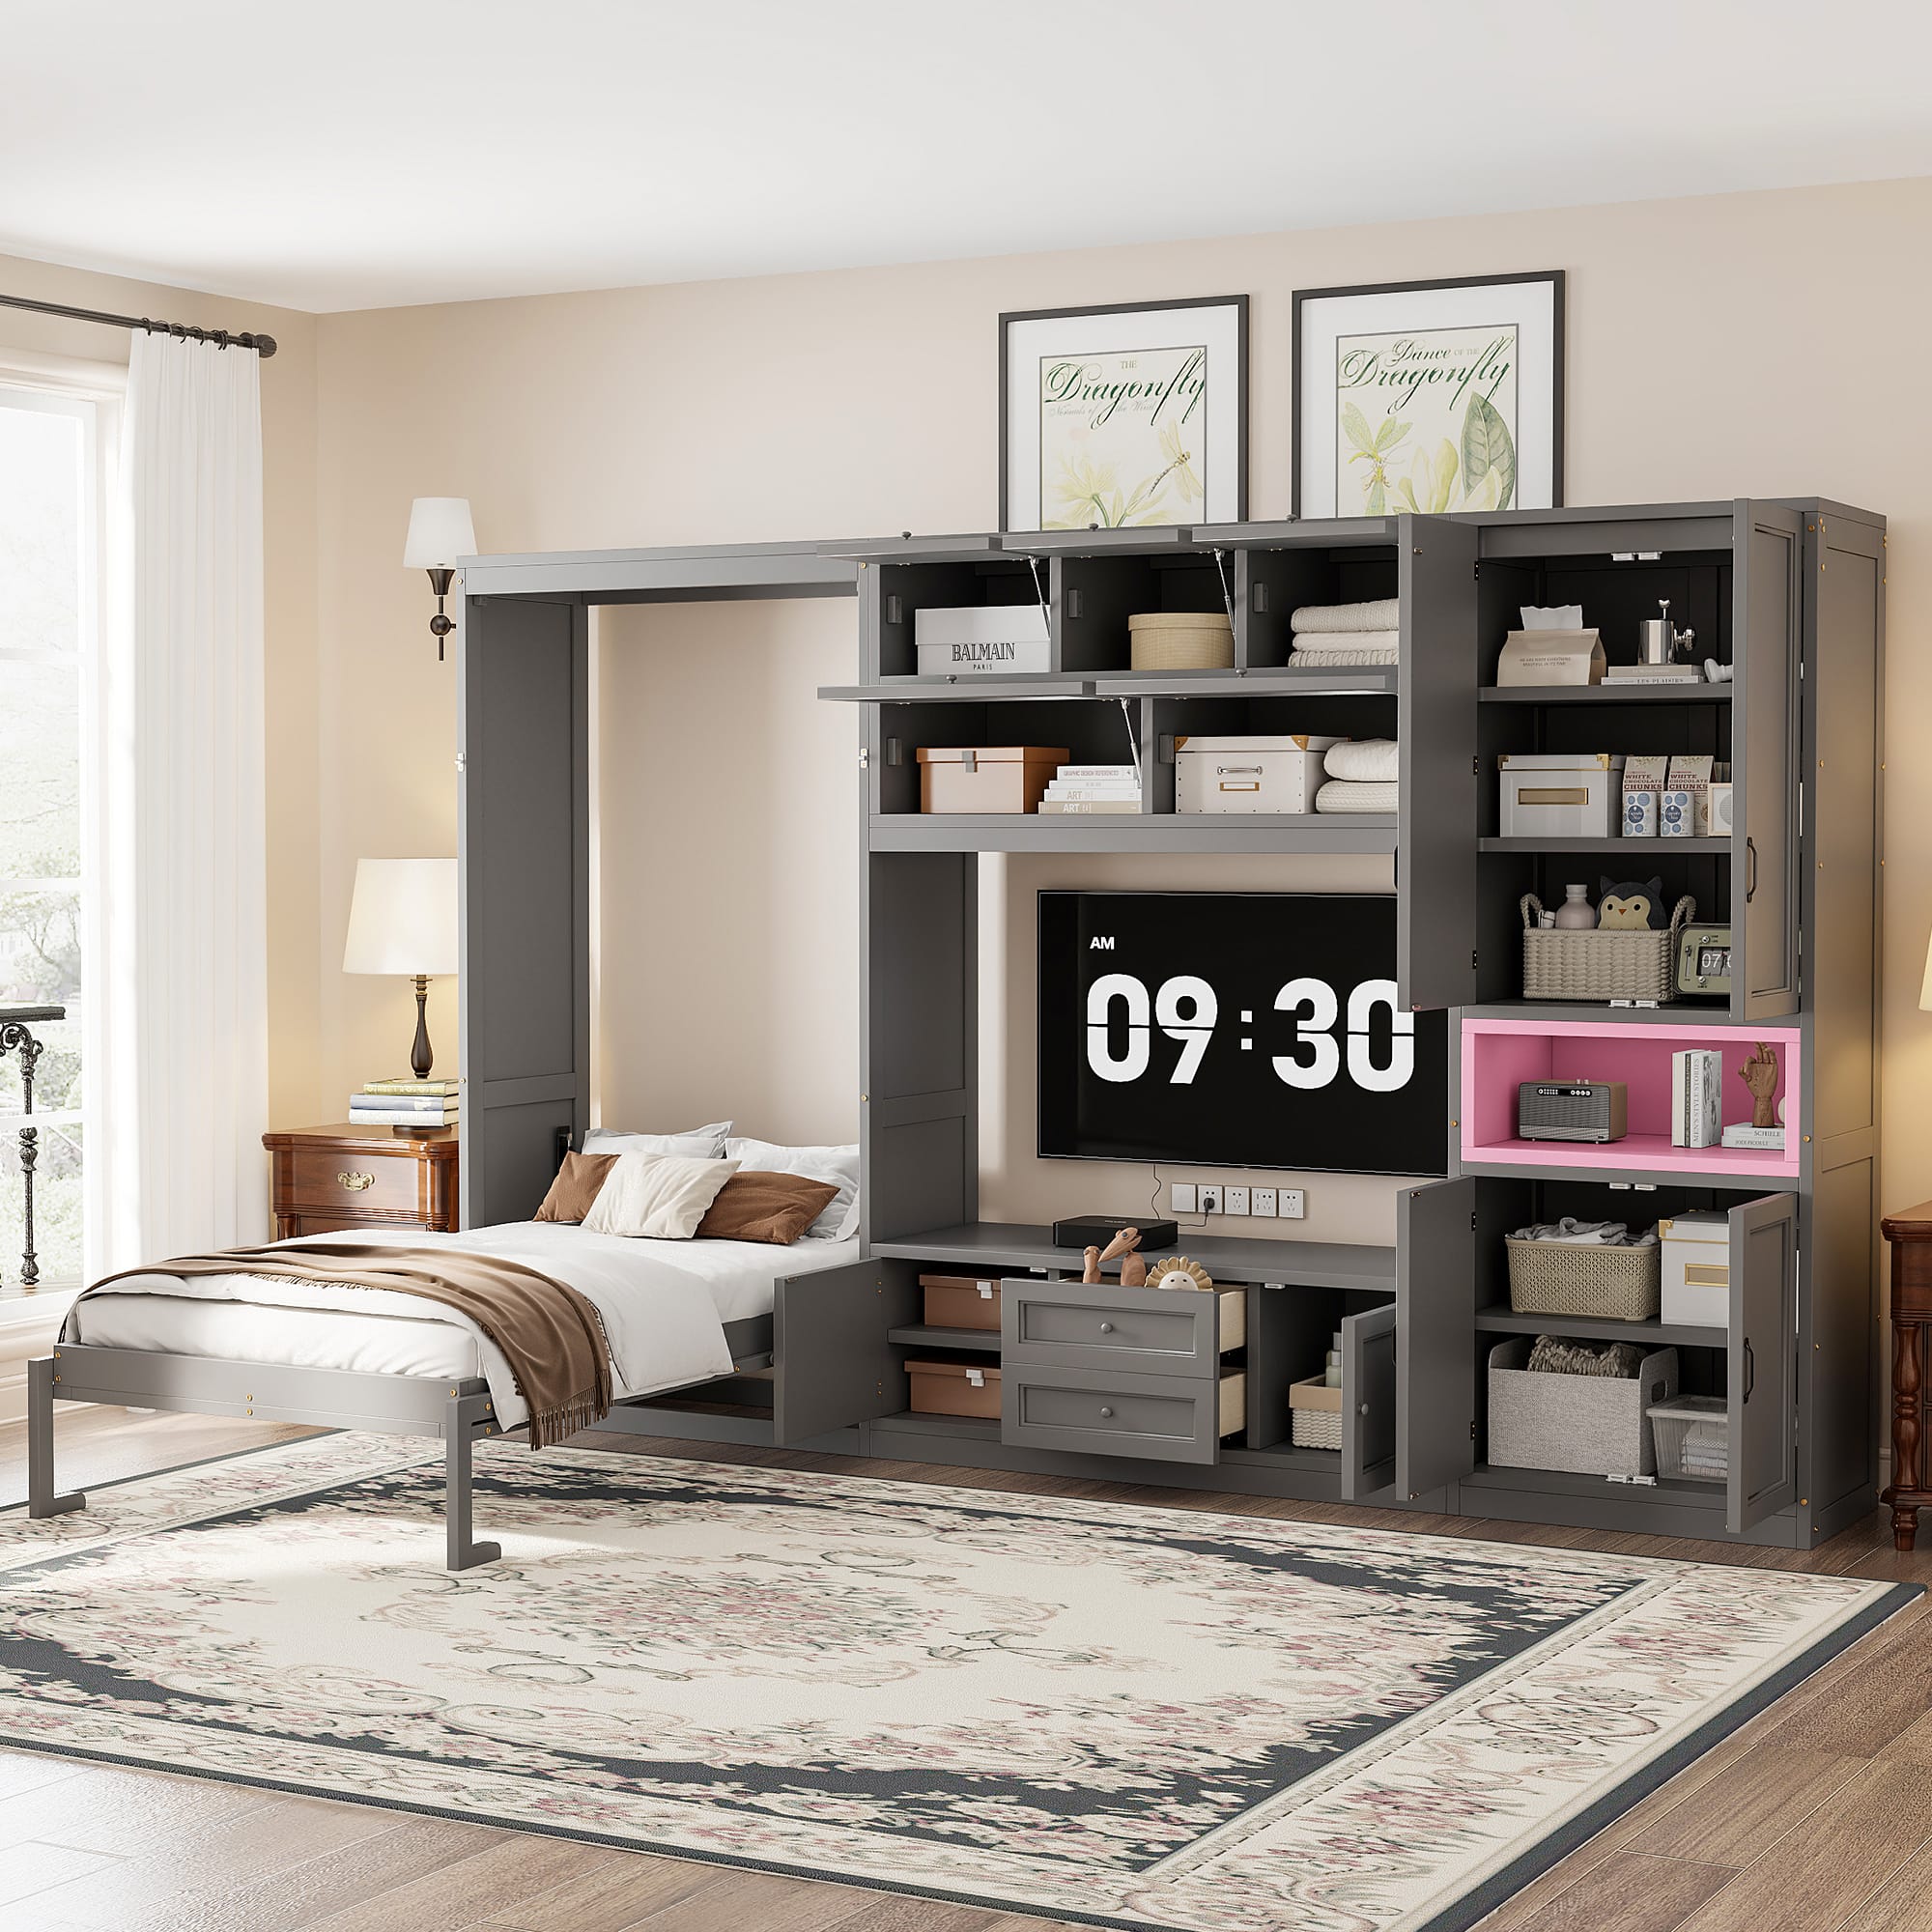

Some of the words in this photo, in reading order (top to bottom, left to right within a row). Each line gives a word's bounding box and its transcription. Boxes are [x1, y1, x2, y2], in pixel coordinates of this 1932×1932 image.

[1390, 339, 1452, 364] Dance
[1120, 360, 1137, 370] THE
[1338, 335, 1515, 414] Dragonfly
[1044, 350, 1205, 430] Dragonfly
[951, 642, 1016, 662] BALMAIN
[1066, 790, 1083, 800] ART
[1063, 804, 1080, 812] ART
[1090, 936, 1115, 950] AM
